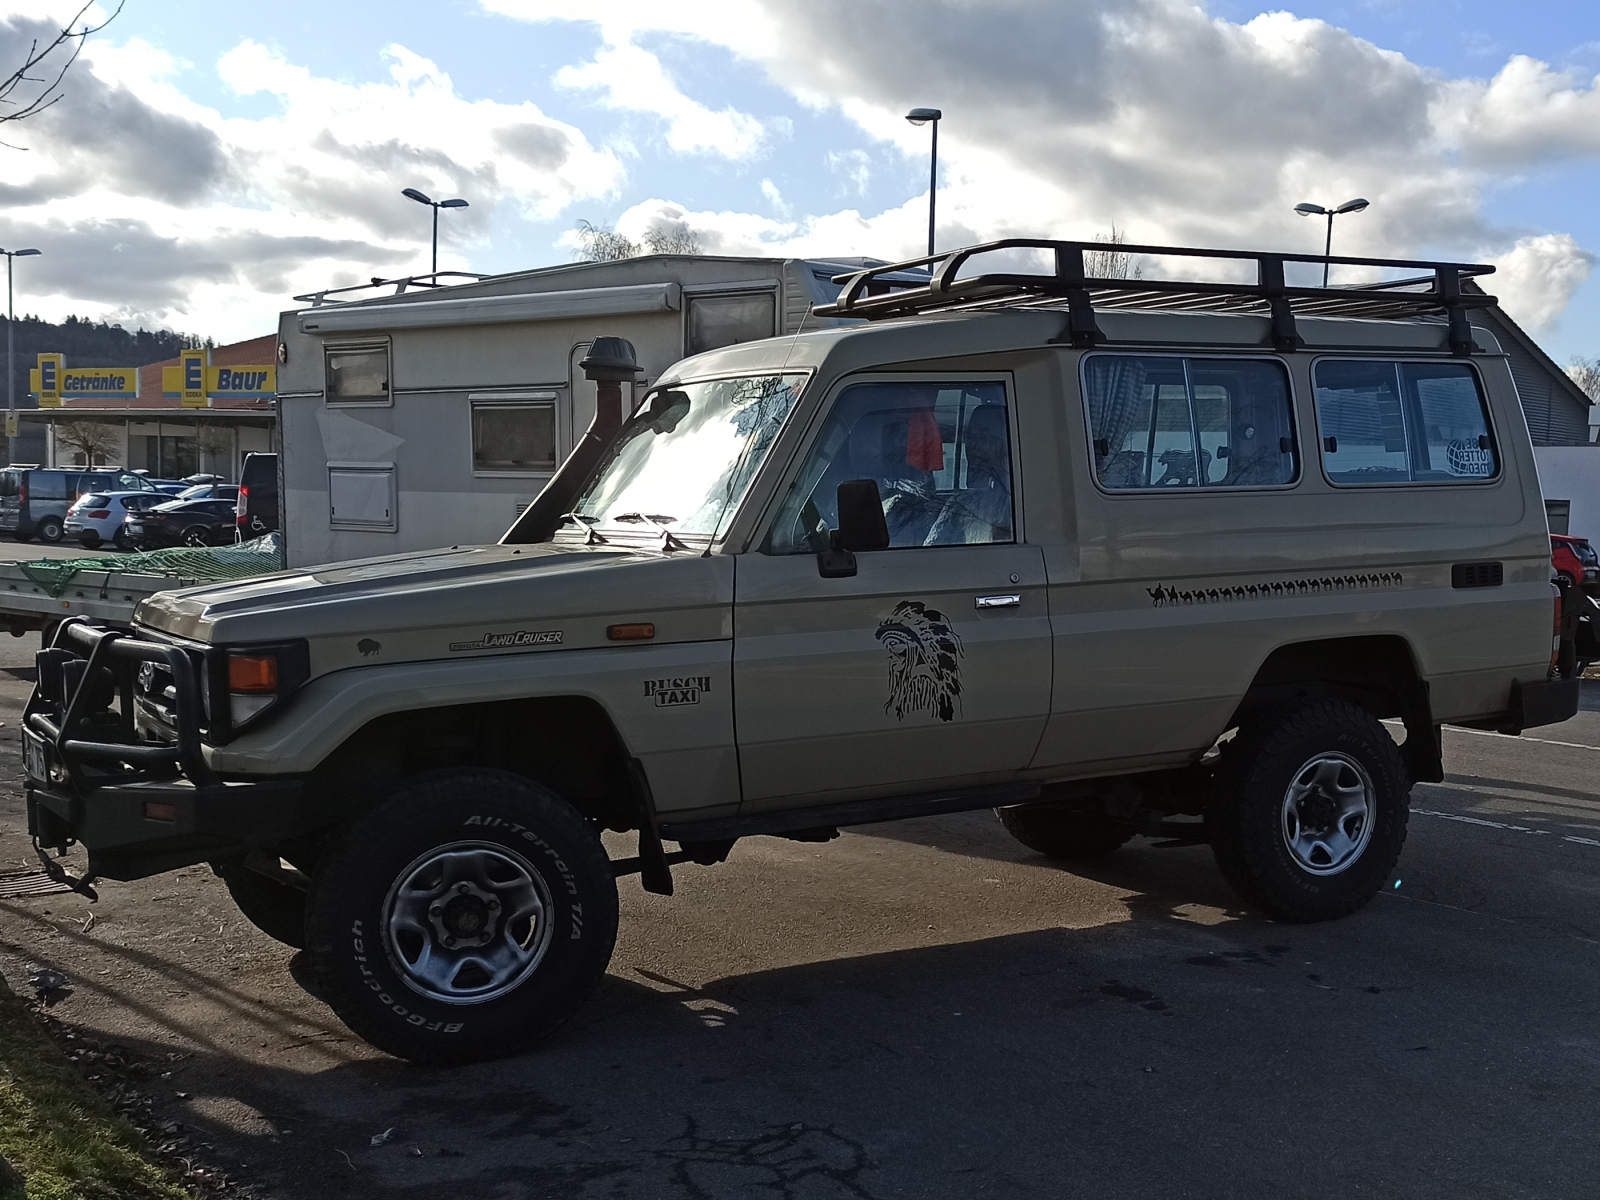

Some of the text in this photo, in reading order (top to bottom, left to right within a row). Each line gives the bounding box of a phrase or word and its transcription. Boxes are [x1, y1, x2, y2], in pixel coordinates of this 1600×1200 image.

[64, 372, 126, 391] Getränke
[217, 368, 268, 391] Baur
[643, 676, 711, 697] BUSCH
[657, 690, 696, 705] TAXI
[462, 815, 584, 940] All-Terrain T/A
[351, 919, 465, 1034] BFGoodrich
